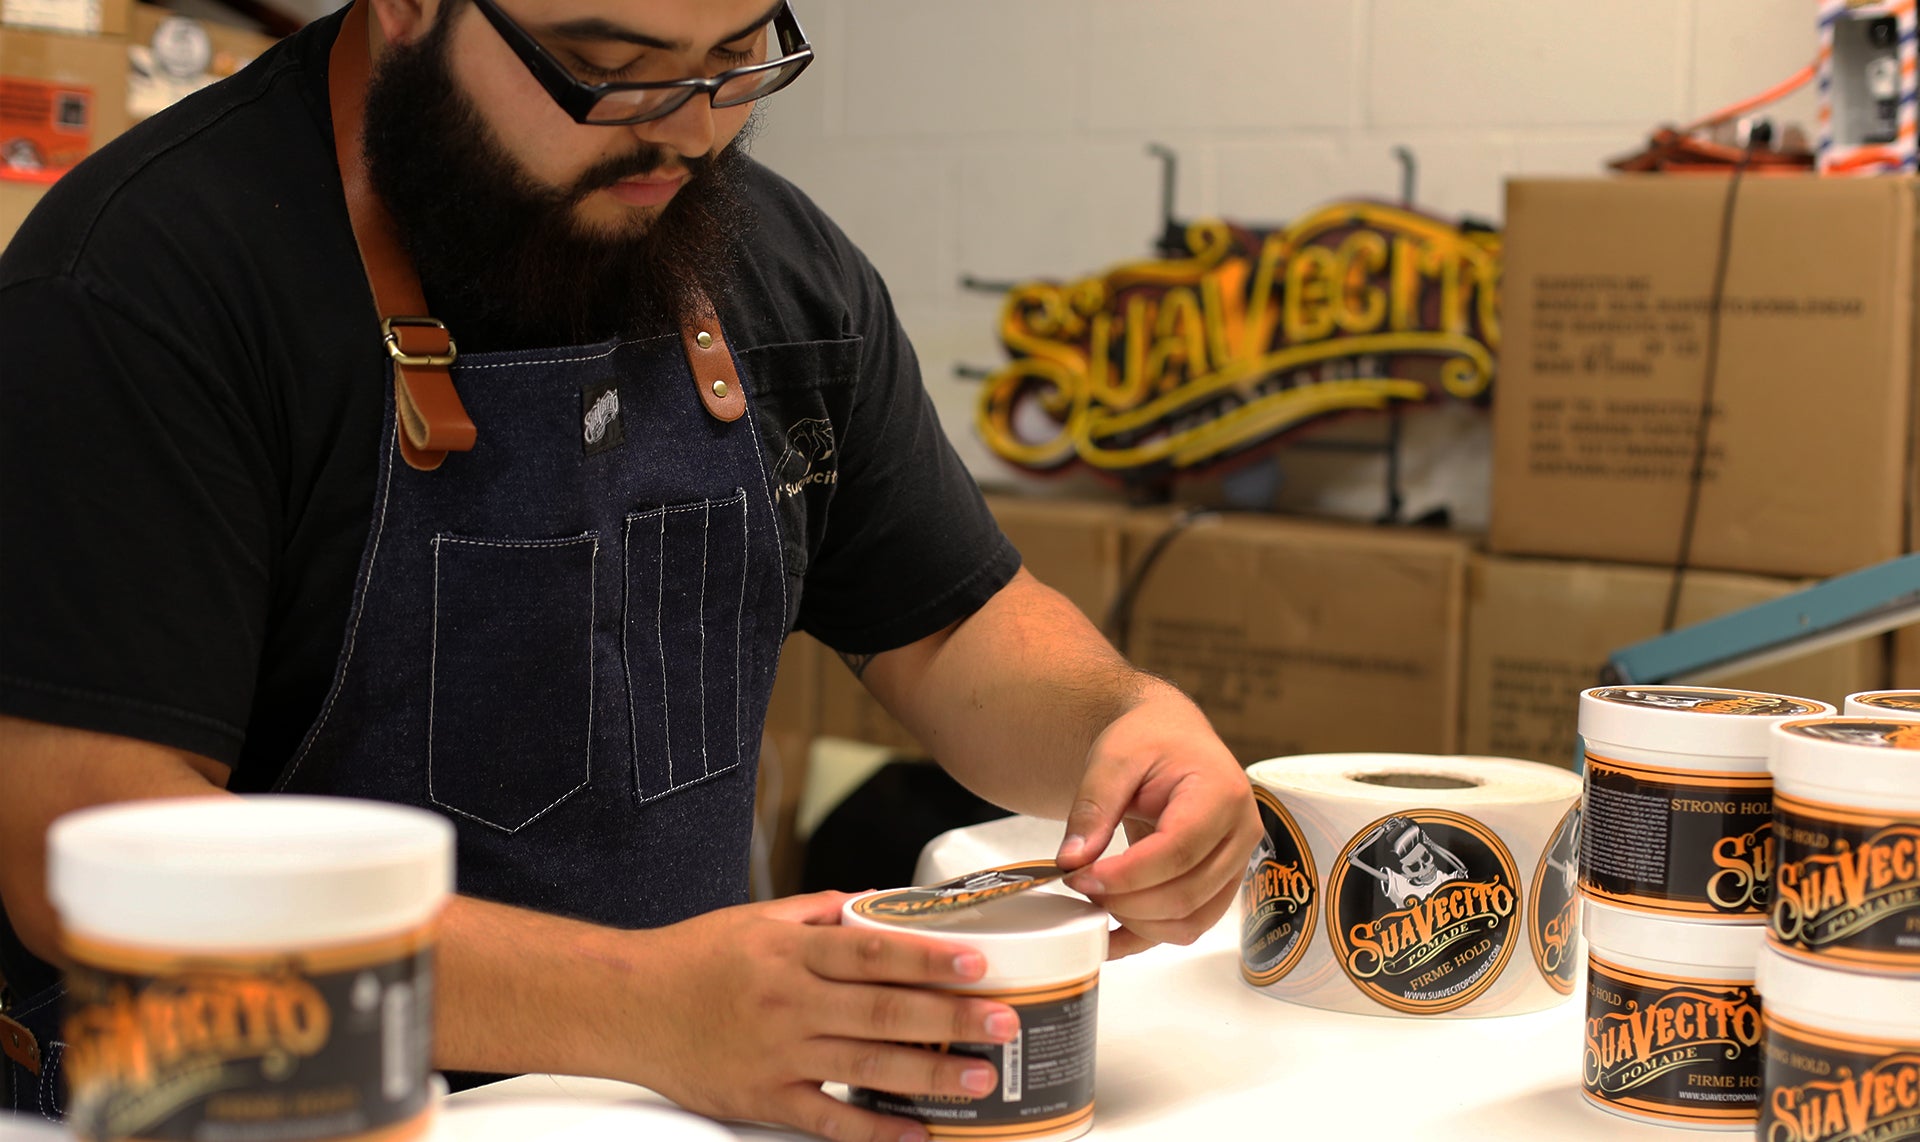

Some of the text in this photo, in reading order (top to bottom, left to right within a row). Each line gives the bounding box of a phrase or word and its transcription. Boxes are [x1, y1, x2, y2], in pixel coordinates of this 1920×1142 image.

[1671, 798, 1773, 815] STRONG HOL
[1773, 826, 1920, 940] SUAVEC
[1348, 875, 1514, 978] SUAVECITO
[1407, 922, 1470, 966] POMADE
[1403, 944, 1503, 1001] WWW.SUAVECITOPOMADE.COM
[1409, 938, 1492, 991] FIRME HOLD
[1583, 987, 1763, 1086] SUAVECITO
[1621, 1047, 1698, 1085] POMADE
[1687, 1074, 1762, 1088] FIRME HO
[1766, 1066, 1920, 1142] SUAVEC
